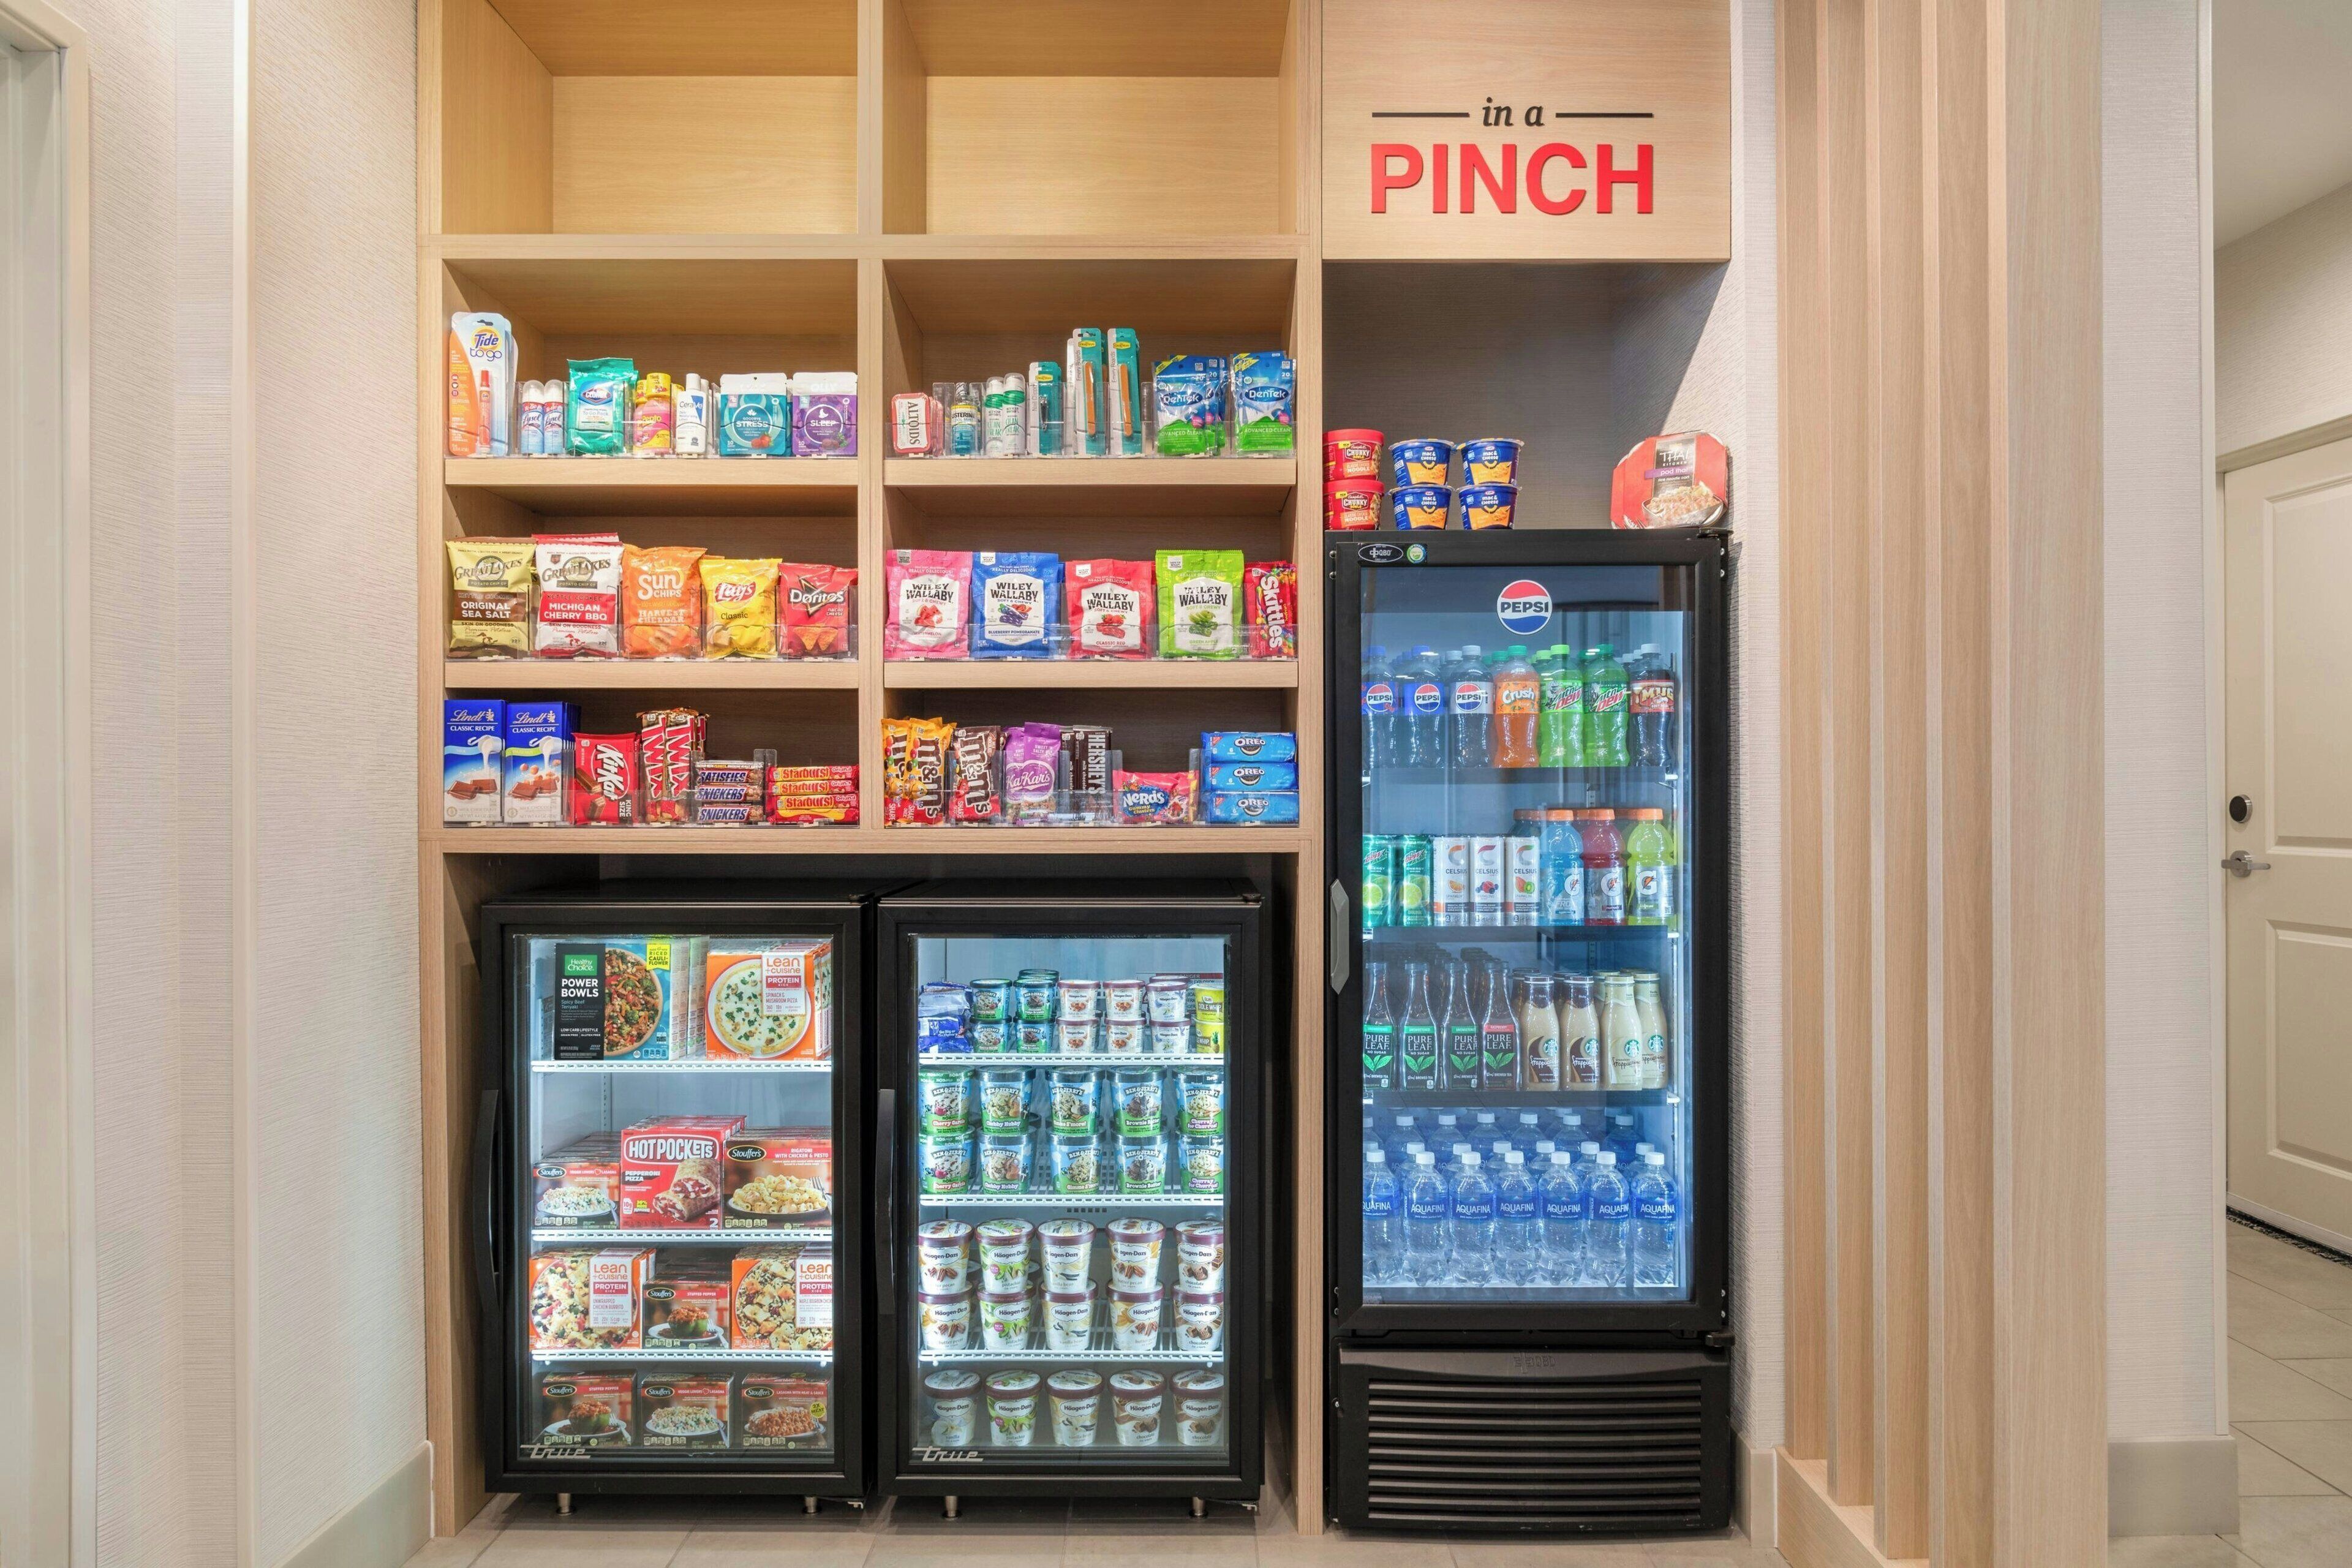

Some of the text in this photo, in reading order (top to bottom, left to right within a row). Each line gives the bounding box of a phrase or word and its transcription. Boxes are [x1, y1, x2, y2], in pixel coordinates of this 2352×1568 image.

[1482, 97, 1545, 127] in a
[1371, 142, 1653, 216] PINCH
[474, 333, 499, 349] Tide
[470, 347, 484, 358] to
[486, 350, 502, 361] go
[1249, 388, 1286, 398] DenTek
[907, 401, 920, 445] ALTOIDS
[1659, 451, 1689, 462] THAI
[455, 562, 490, 580] GREAT
[542, 563, 577, 582] GREAT
[638, 568, 685, 600] Sun
[653, 589, 682, 598] CHIPS
[790, 589, 844, 604] Doritos
[906, 590, 954, 603] WALLABY
[990, 589, 1038, 603] WALLABY
[461, 601, 511, 610] ORIGINAL
[549, 603, 600, 611] MICHIGAN
[1087, 599, 1134, 612] WALLABY
[1179, 594, 1228, 607] WALLABY
[1501, 601, 1549, 612] PEPSI
[586, 612, 608, 621] BBQ
[720, 611, 748, 620] Classic
[1260, 575, 1286, 649] Skittles
[1502, 688, 1535, 704] Crush
[1642, 687, 1674, 702] MUG
[450, 709, 486, 722] Lindt
[512, 712, 548, 724] Lindt
[1234, 737, 1266, 747] OREO
[642, 715, 666, 799] TWIX
[666, 715, 695, 799] TWIX
[1088, 734, 1106, 794] HERSHEY'S
[699, 771, 747, 783] SATISFIES
[782, 767, 830, 780] Starburst
[1233, 767, 1265, 777] OREO
[695, 787, 745, 801] SNICKERS
[781, 782, 829, 794] Starburst
[785, 796, 834, 809] Starburst
[1237, 798, 1269, 807] OREO
[699, 807, 748, 821] SNICKERS
[571, 959, 593, 968] Healthy
[767, 957, 801, 967] Lean
[561, 989, 599, 997] BOWLS
[629, 1138, 714, 1161] HOT POCKETS
[731, 1148, 762, 1159] Stouffer's
[1411, 1204, 1446, 1215] AQUAFINA
[1456, 1204, 1491, 1215] AQUAFINA
[1501, 1202, 1535, 1213] AQUAFINA
[1547, 1203, 1581, 1214] AQUAFINA
[1640, 1202, 1675, 1214] AQUAFINA
[709, 1217, 718, 1227] 2
[594, 1264, 627, 1273] Lean
[520, 1442, 591, 1459] true
[912, 1446, 984, 1461] true
